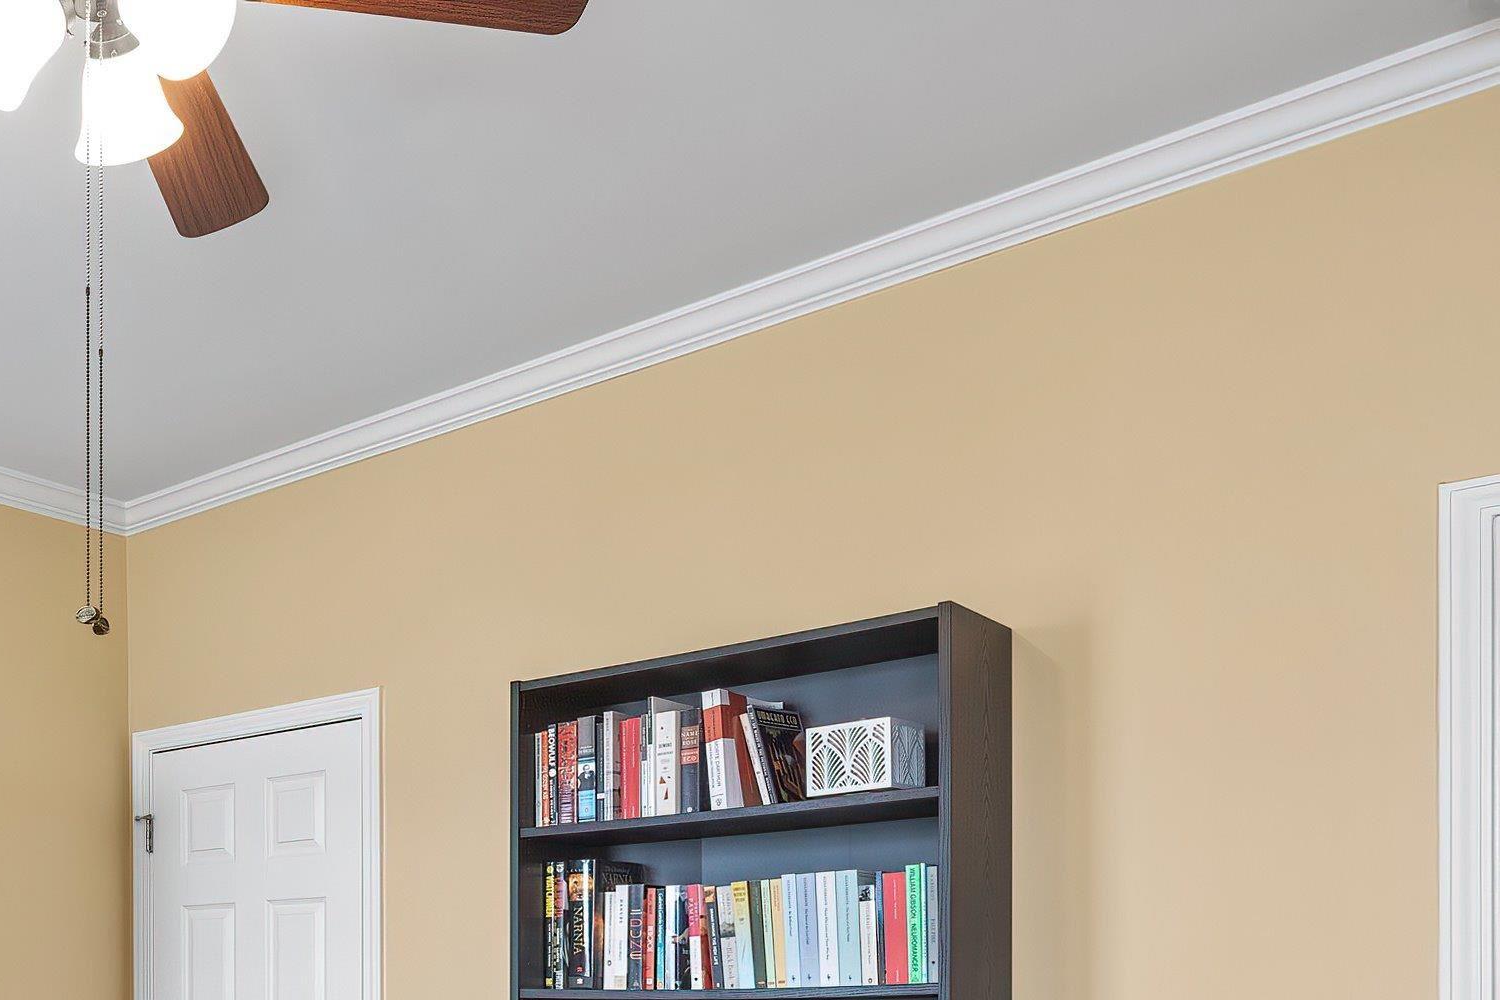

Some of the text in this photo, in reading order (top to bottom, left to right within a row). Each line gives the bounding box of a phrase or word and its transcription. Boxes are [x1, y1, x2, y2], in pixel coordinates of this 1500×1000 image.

[548, 729, 556, 766] BEOWULF
[546, 876, 554, 918] WATCHMEN
[573, 906, 583, 954] NARNIA
